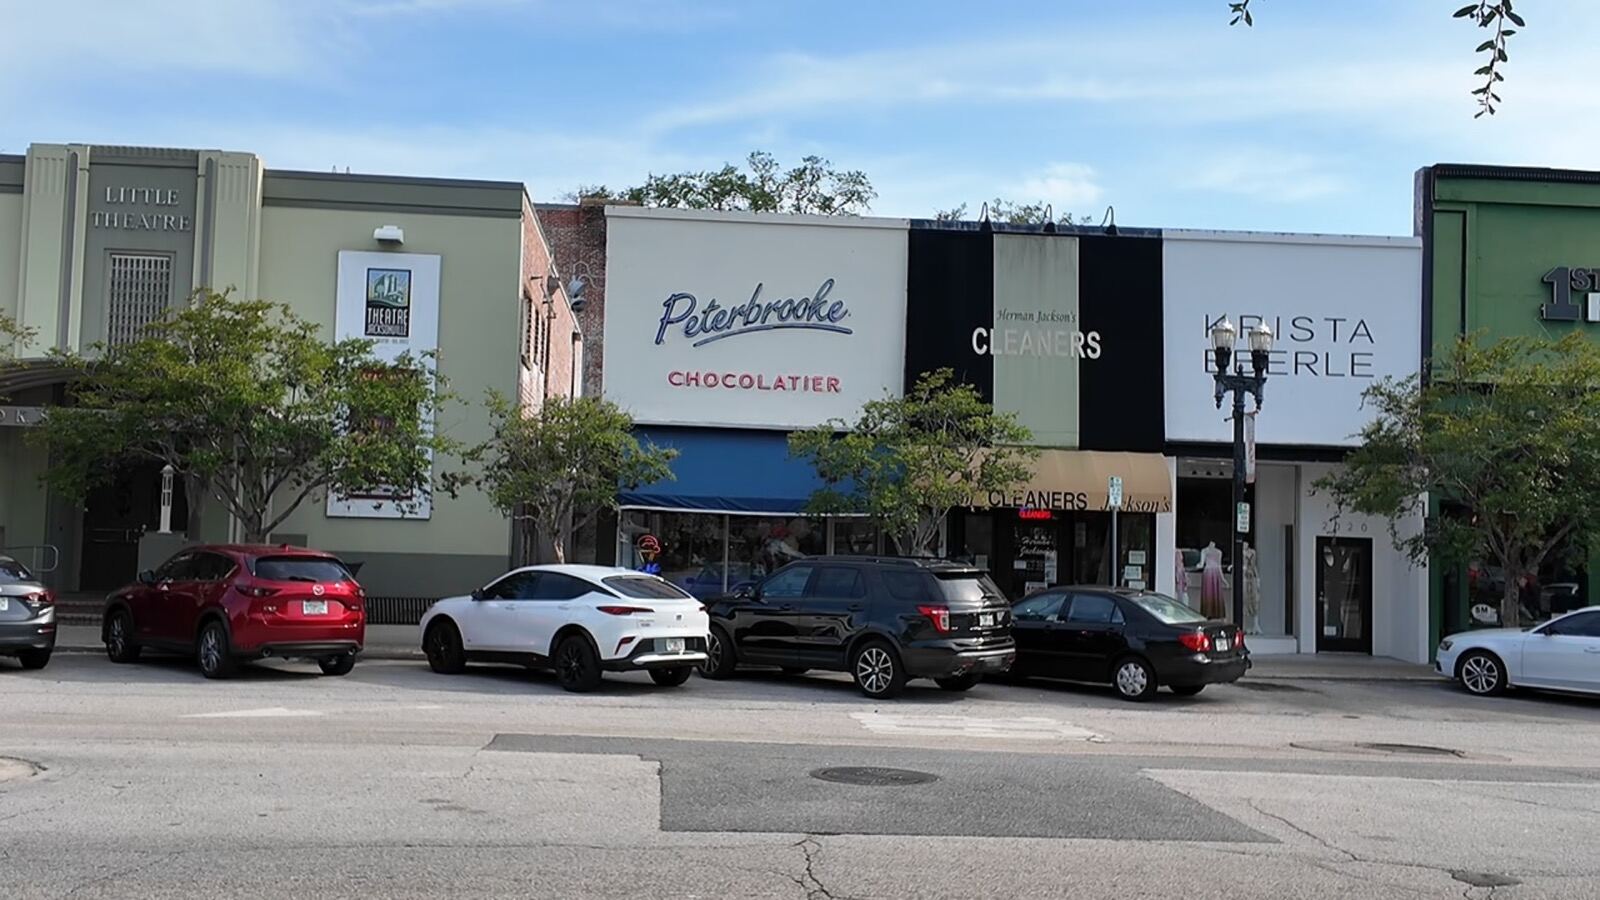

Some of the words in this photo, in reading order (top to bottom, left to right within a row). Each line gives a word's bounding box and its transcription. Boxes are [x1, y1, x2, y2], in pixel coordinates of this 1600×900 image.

[105, 186, 180, 206] LITTLE
[91, 211, 191, 232] THEATRE
[367, 307, 408, 326] THEATRE
[655, 278, 849, 345] Peterbrooke
[997, 308, 1034, 322] Herman
[1036, 309, 1076, 323] Jackson's
[971, 326, 1102, 360] CLEANERS
[668, 370, 842, 394] CHOCOLATIER
[987, 491, 1088, 510] CLEANERS
[1100, 494, 1171, 512] Jkson's
